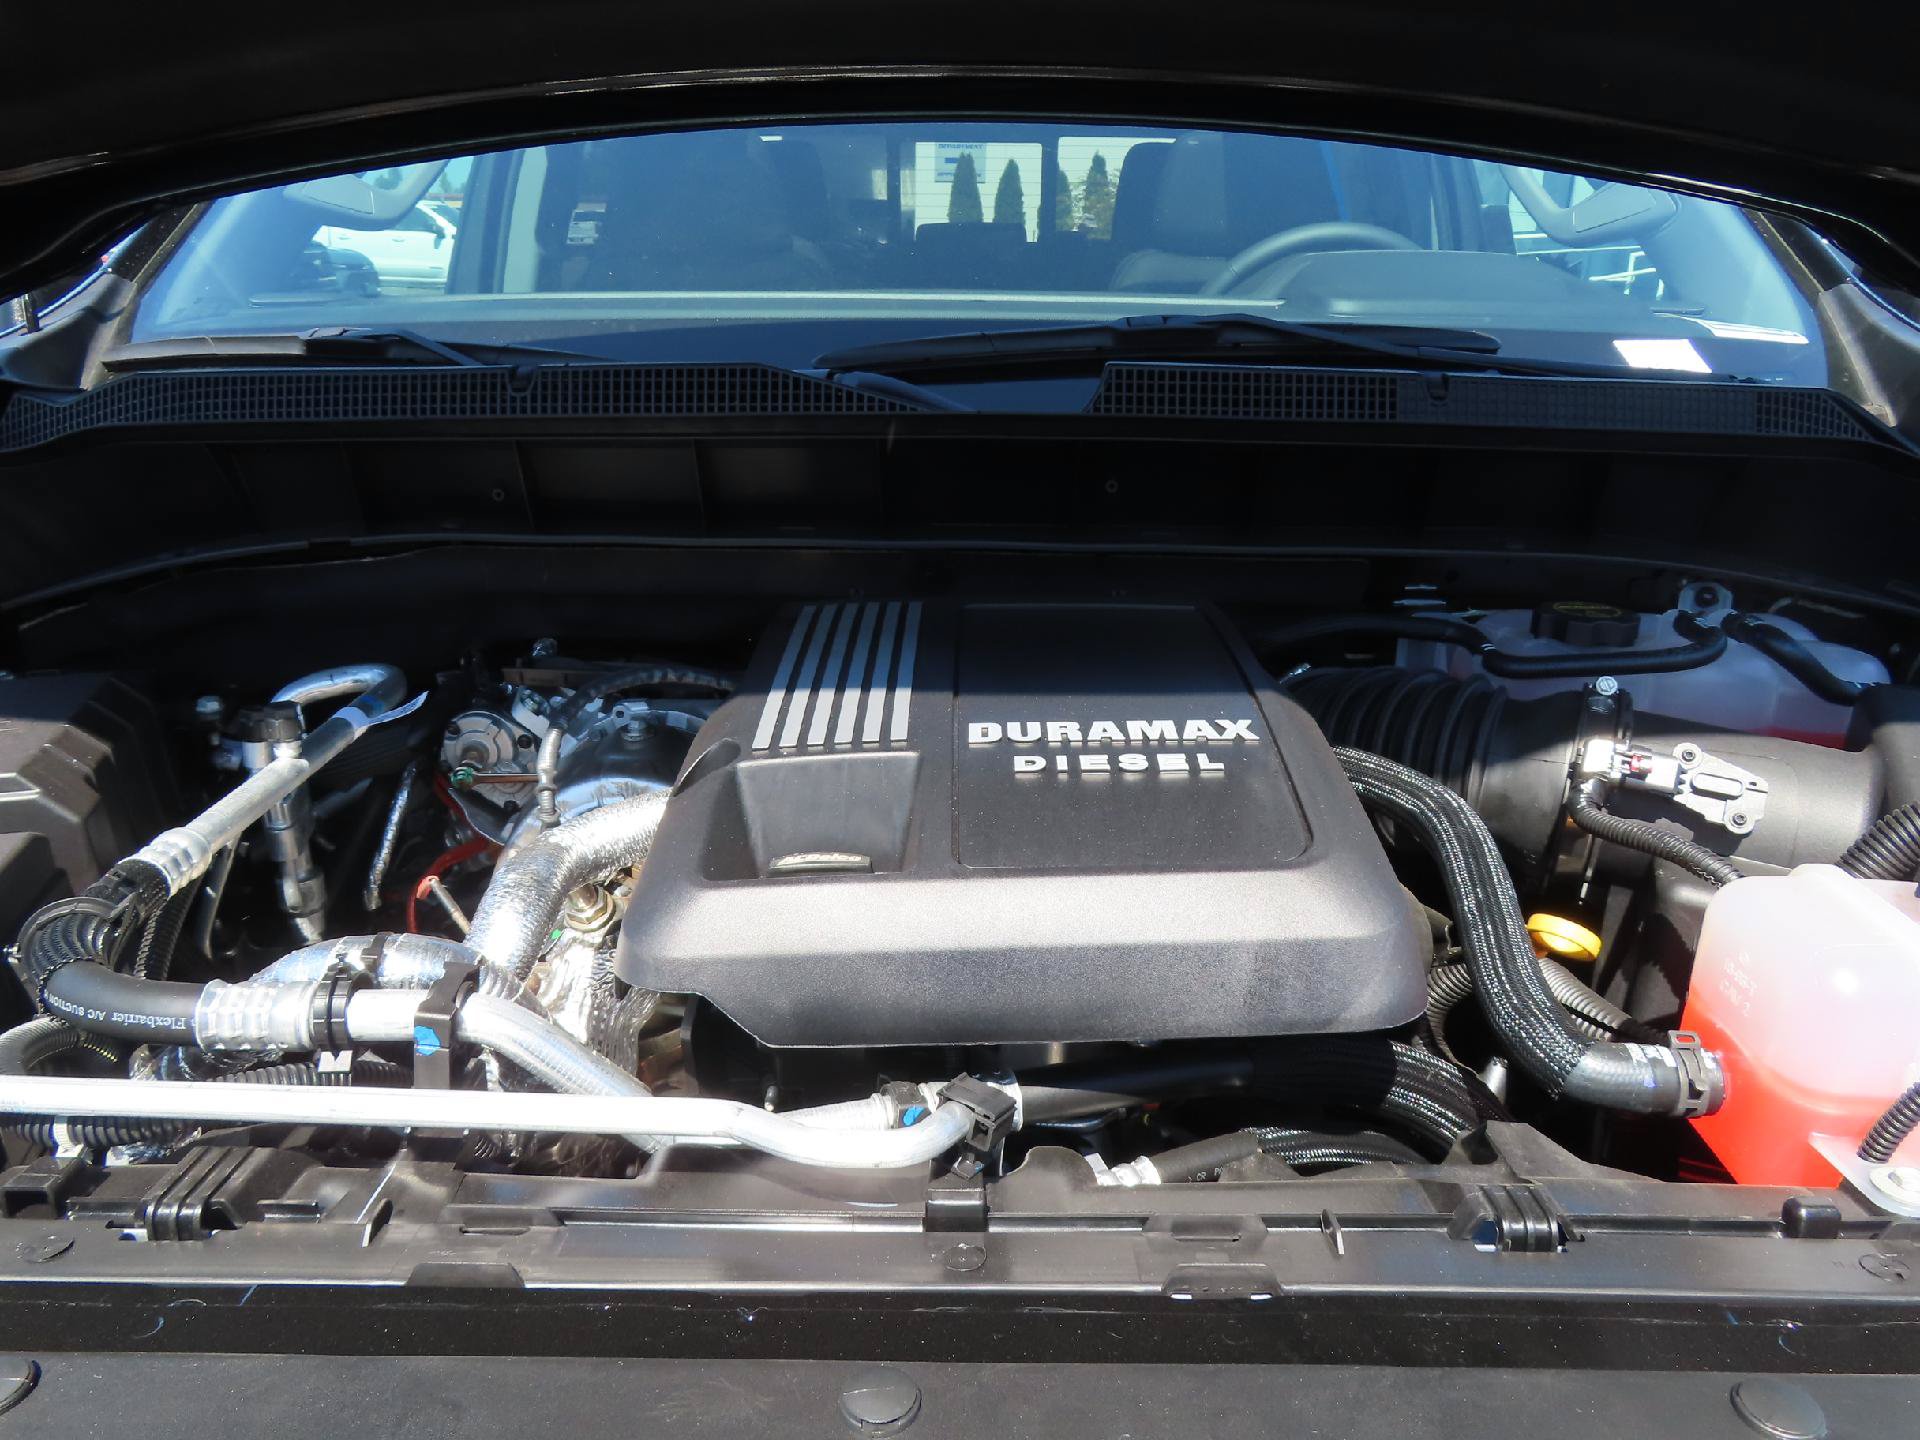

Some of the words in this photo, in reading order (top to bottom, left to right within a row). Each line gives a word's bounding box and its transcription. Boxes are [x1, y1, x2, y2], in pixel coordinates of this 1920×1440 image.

[968, 719, 1261, 744] DURAMAX
[1013, 753, 1225, 774] DIESEL
[48, 993, 85, 1016] SUCTION
[87, 1009, 106, 1021] A/C
[111, 1011, 187, 1030] Flexbarrier
